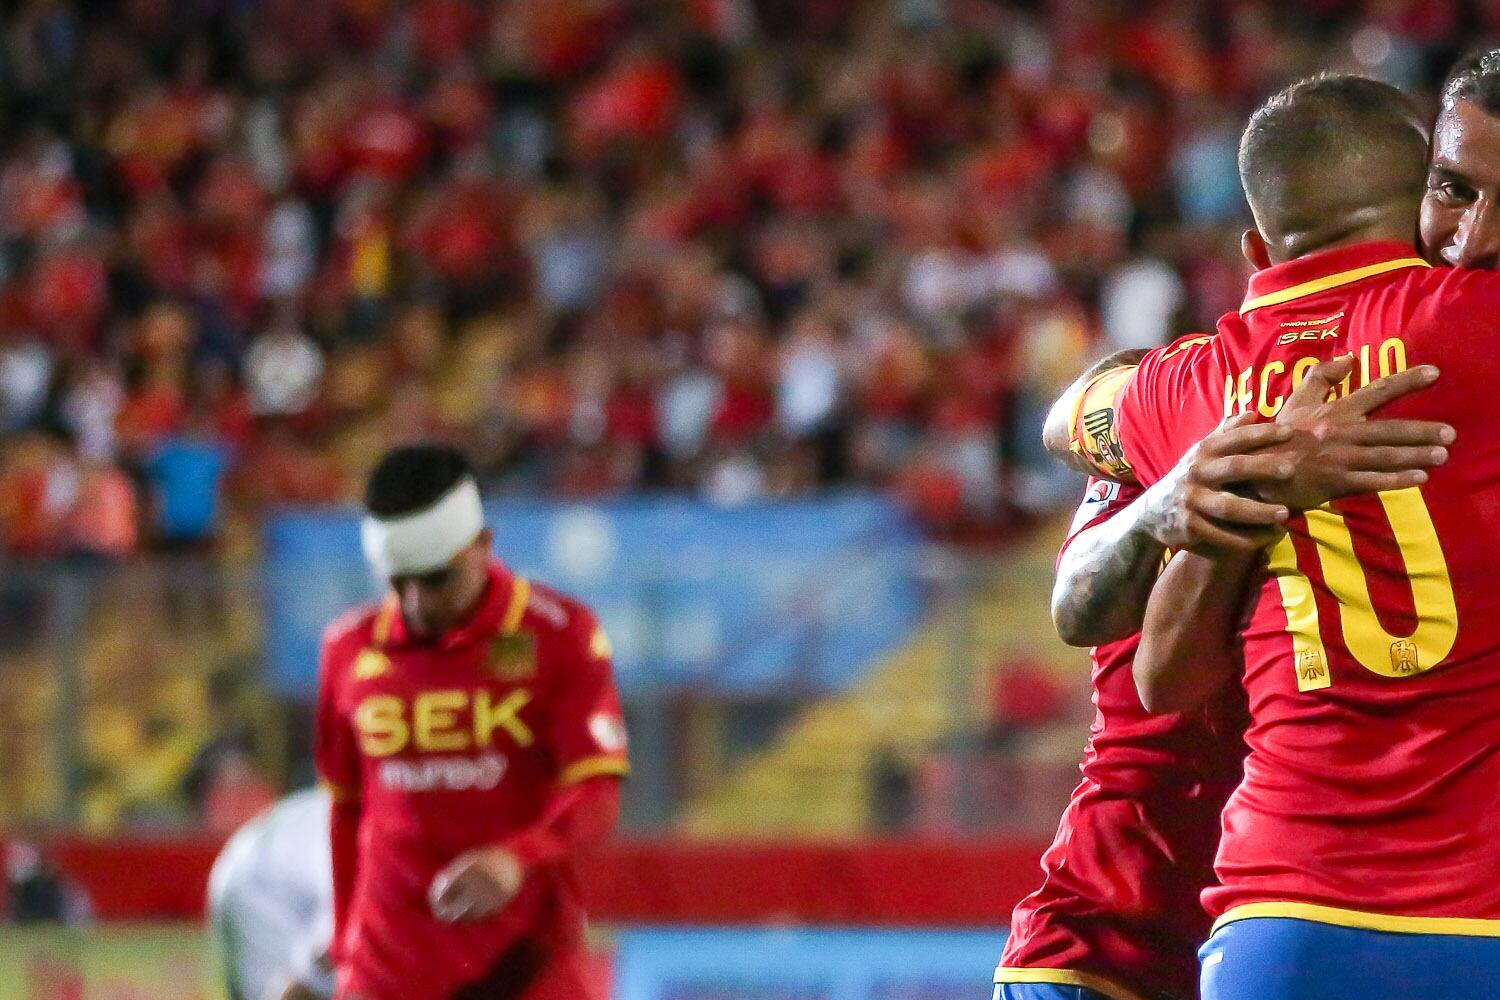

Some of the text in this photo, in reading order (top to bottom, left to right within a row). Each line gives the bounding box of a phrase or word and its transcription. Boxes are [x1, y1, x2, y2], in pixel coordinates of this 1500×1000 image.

[1278, 325, 1340, 345] SEK
[1267, 487, 1459, 692] 10
[354, 687, 534, 757] SEK
